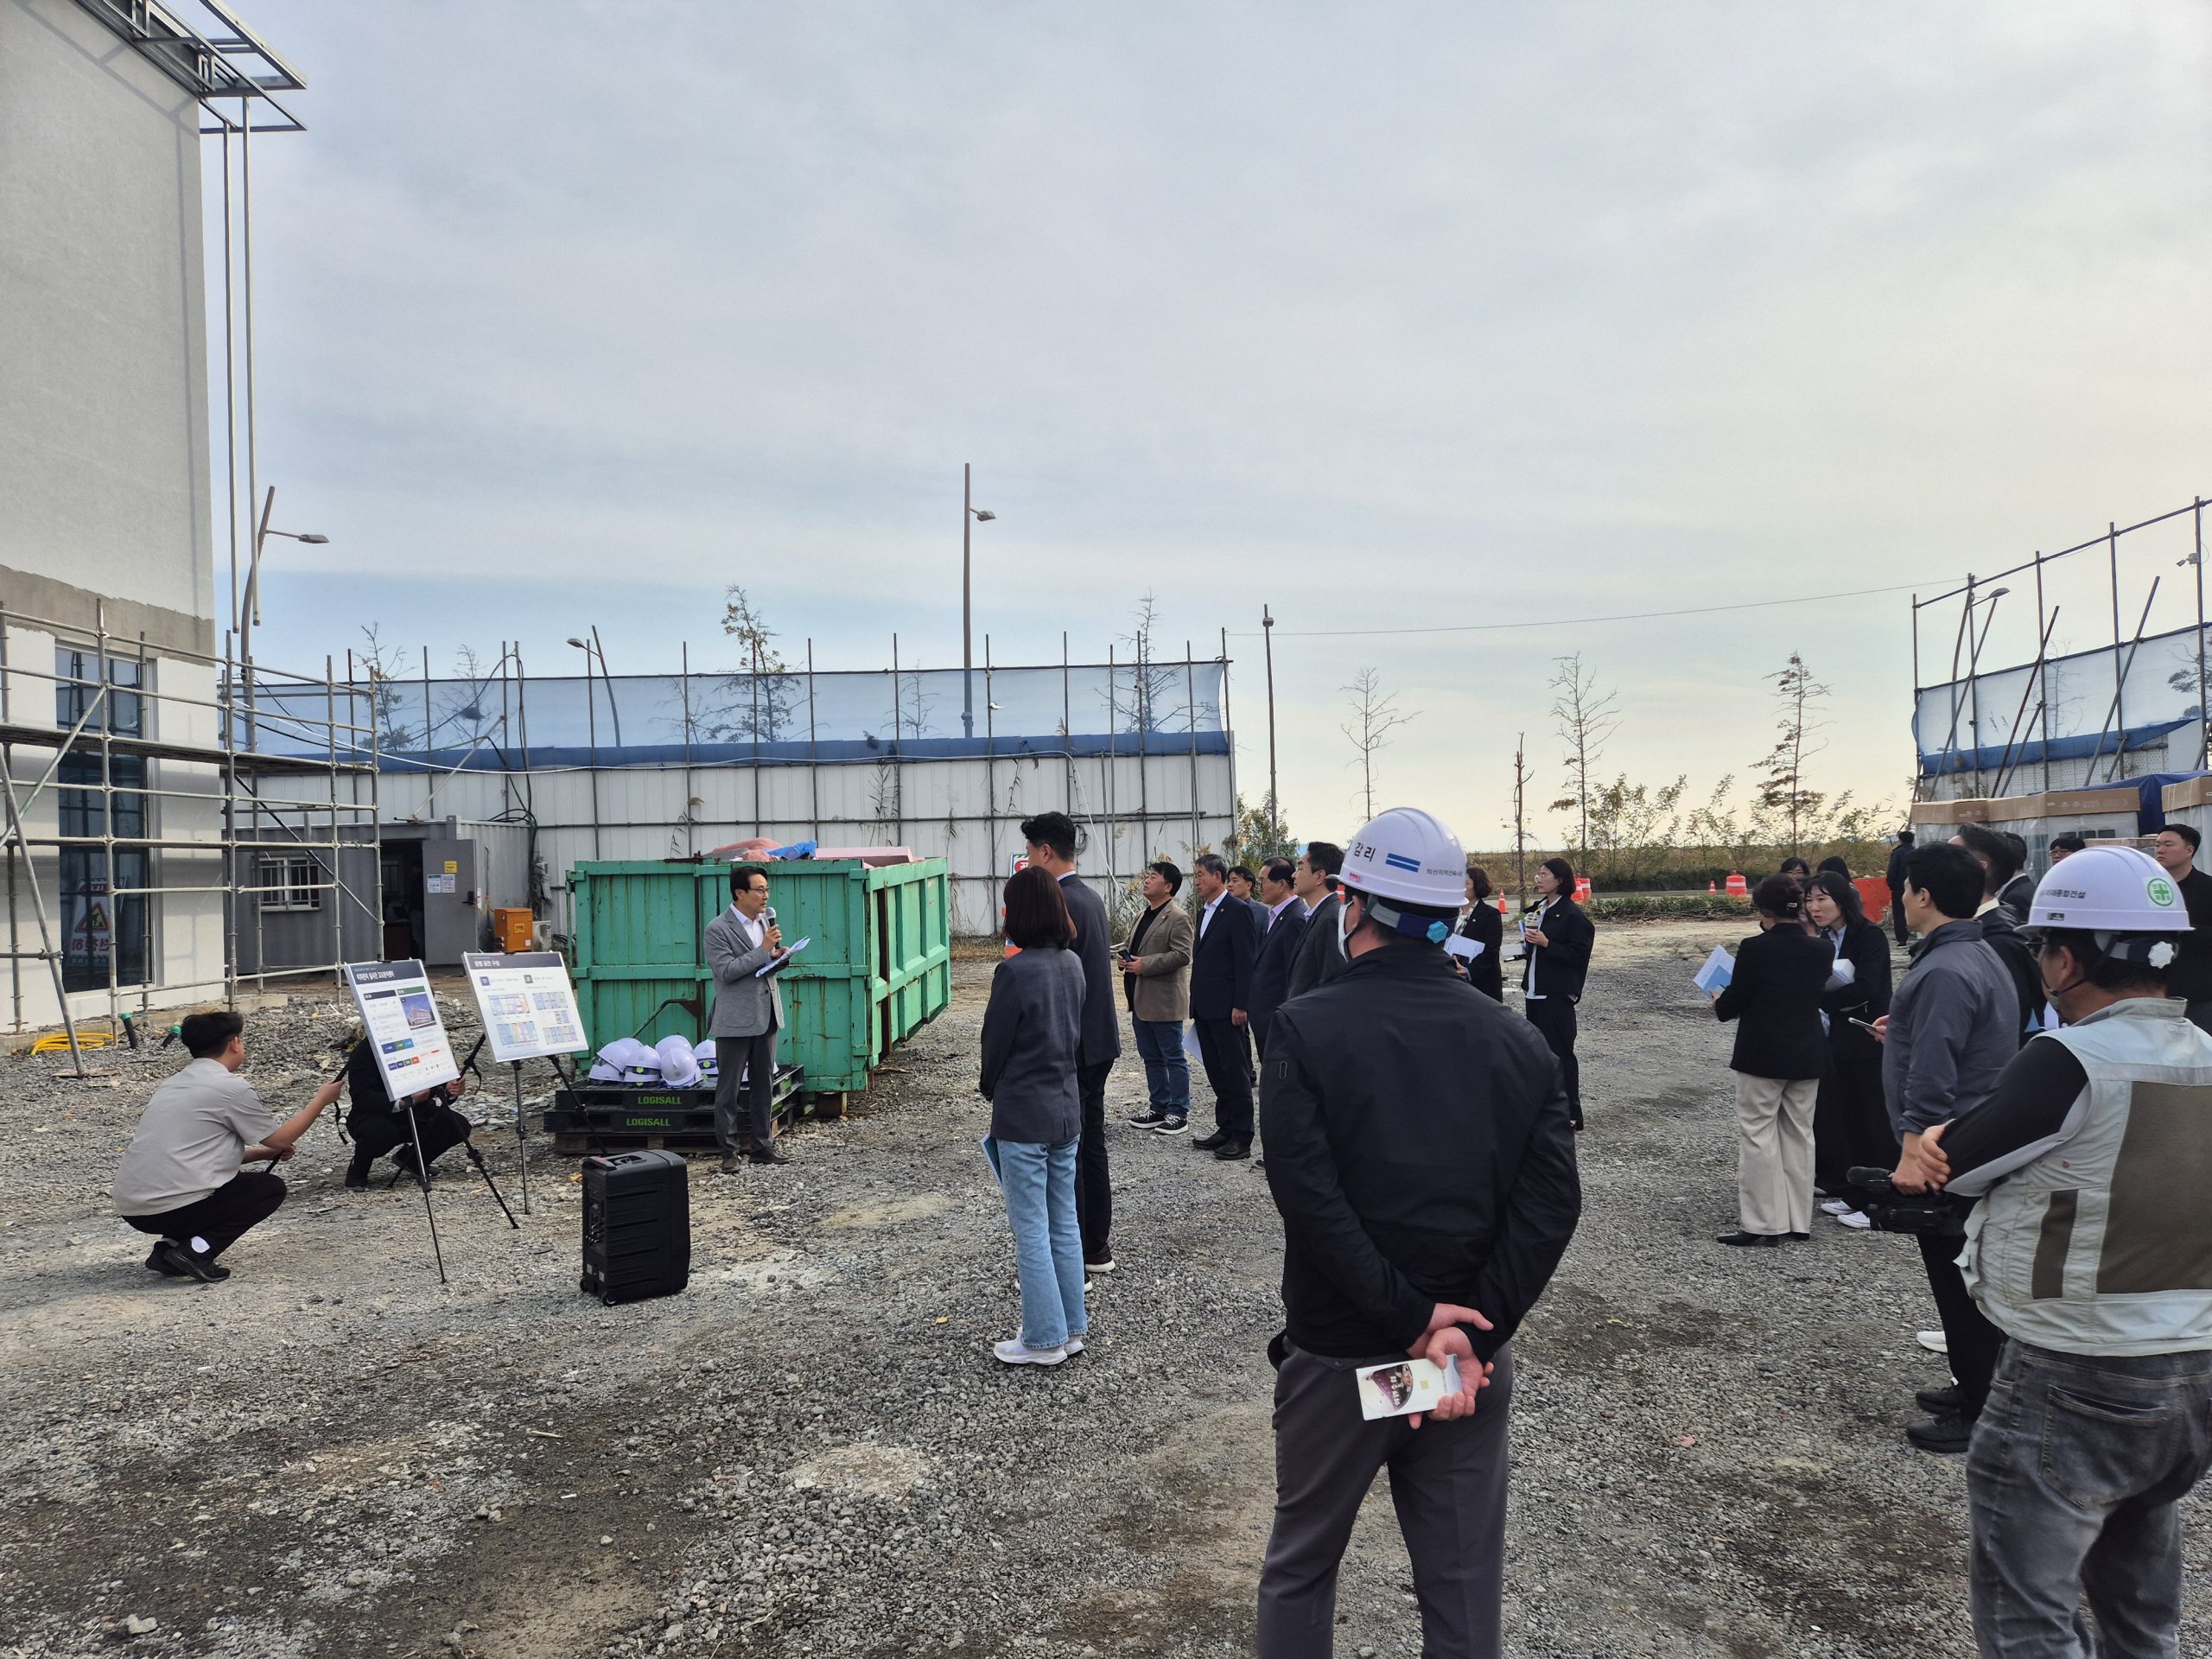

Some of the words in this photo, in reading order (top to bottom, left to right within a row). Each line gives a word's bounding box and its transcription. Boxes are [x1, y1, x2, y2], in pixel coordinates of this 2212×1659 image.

[1354, 842, 1376, 862] 감리
[638, 1096, 683, 1105] LOGISALL
[626, 1117, 671, 1127] LOGISALL
